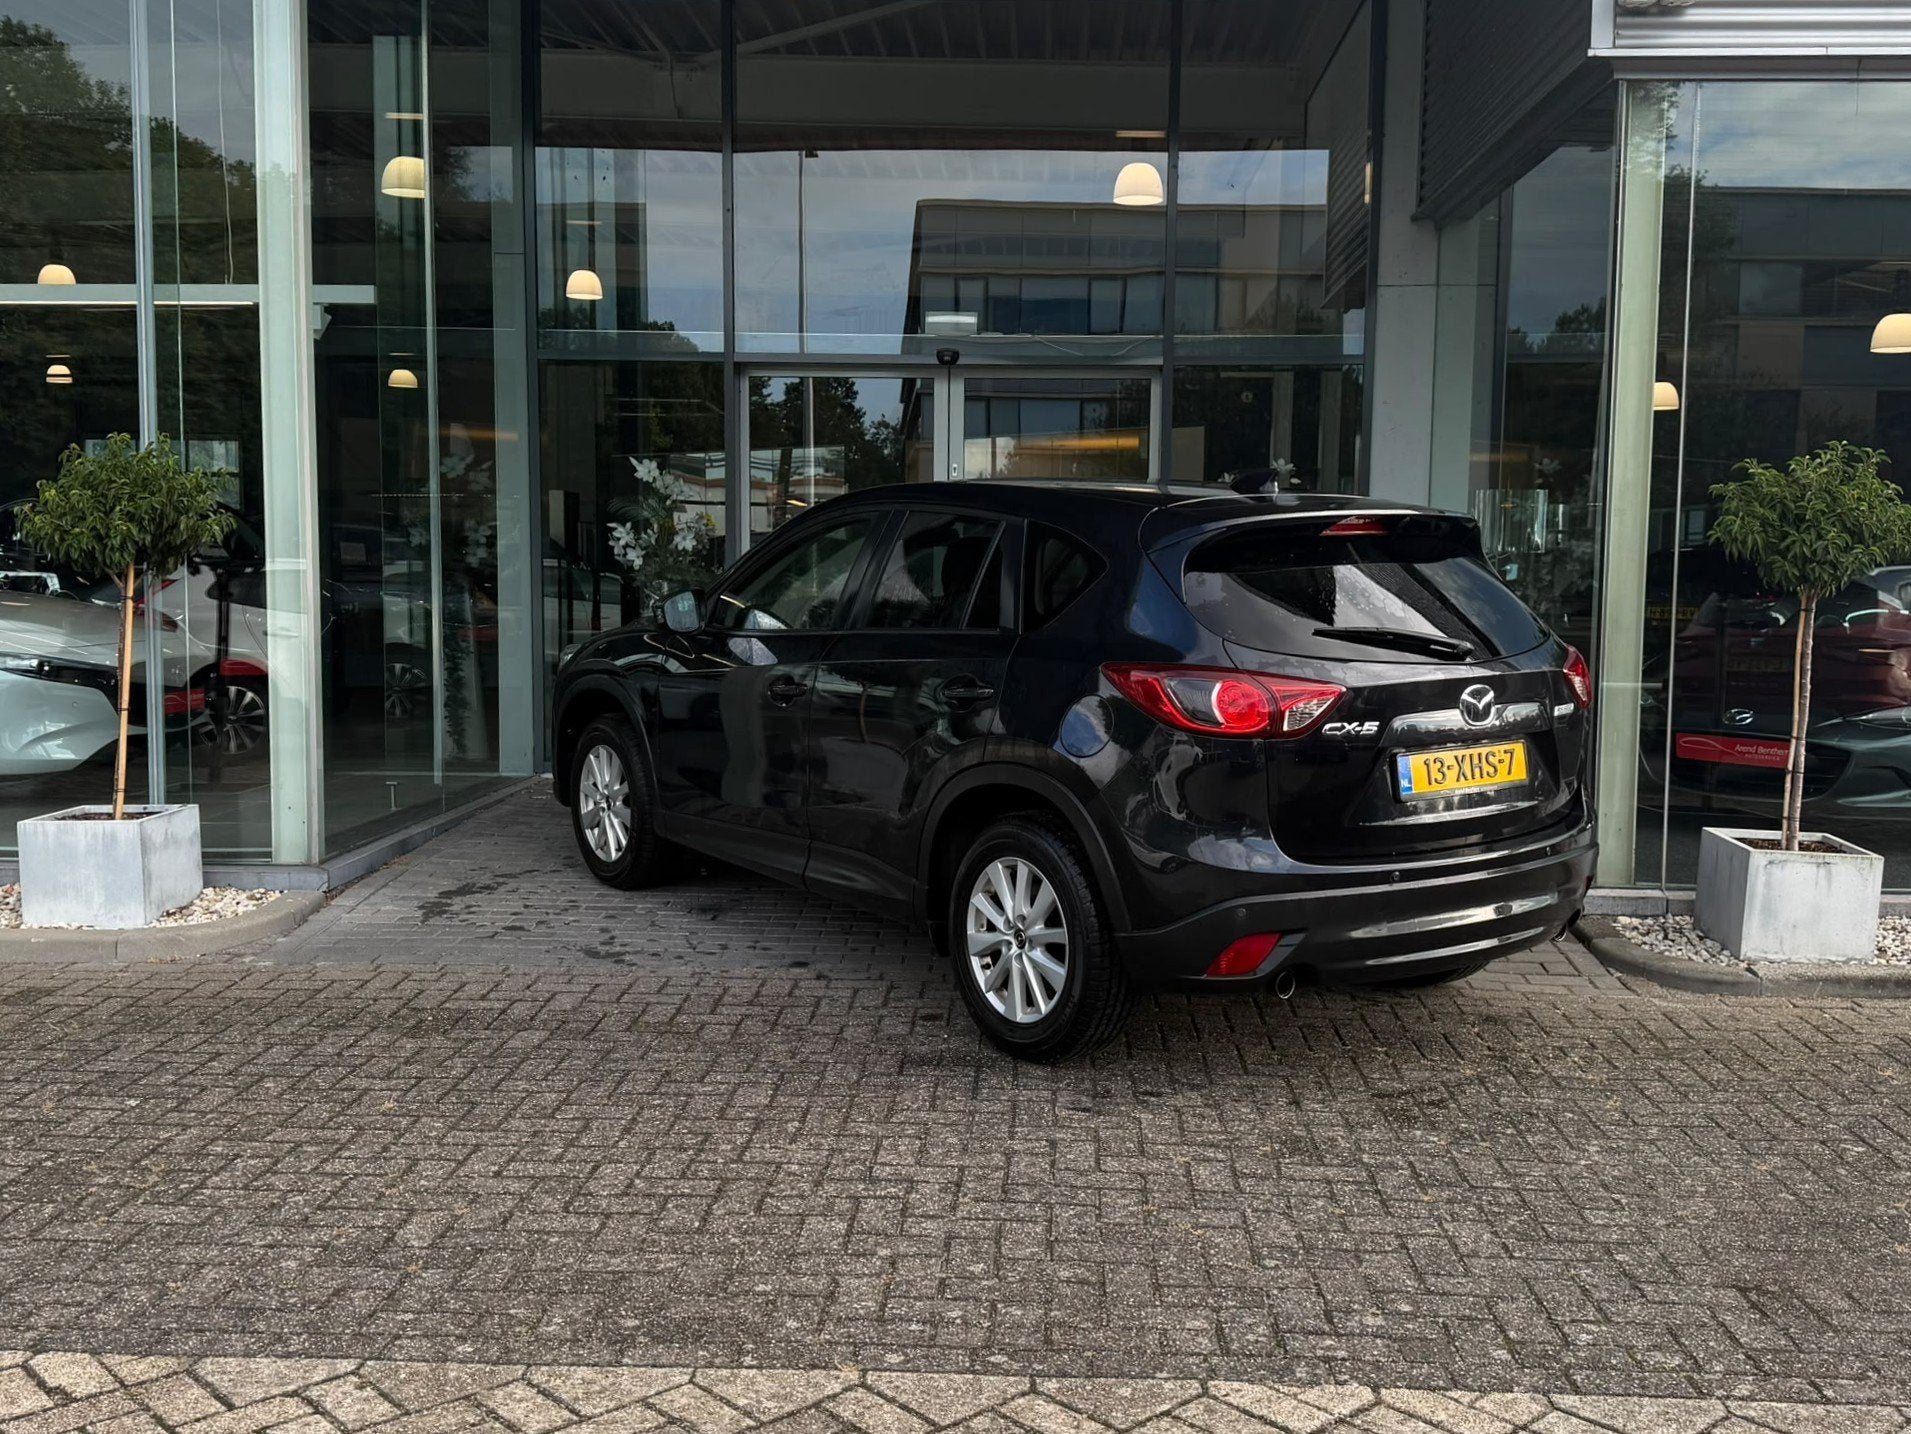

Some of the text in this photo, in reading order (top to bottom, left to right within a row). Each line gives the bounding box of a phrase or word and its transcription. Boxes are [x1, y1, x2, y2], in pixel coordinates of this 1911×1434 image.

[1322, 721, 1380, 735] CX-5
[1423, 748, 1516, 786] 13-XHS-7
[1401, 779, 1412, 788] NL
